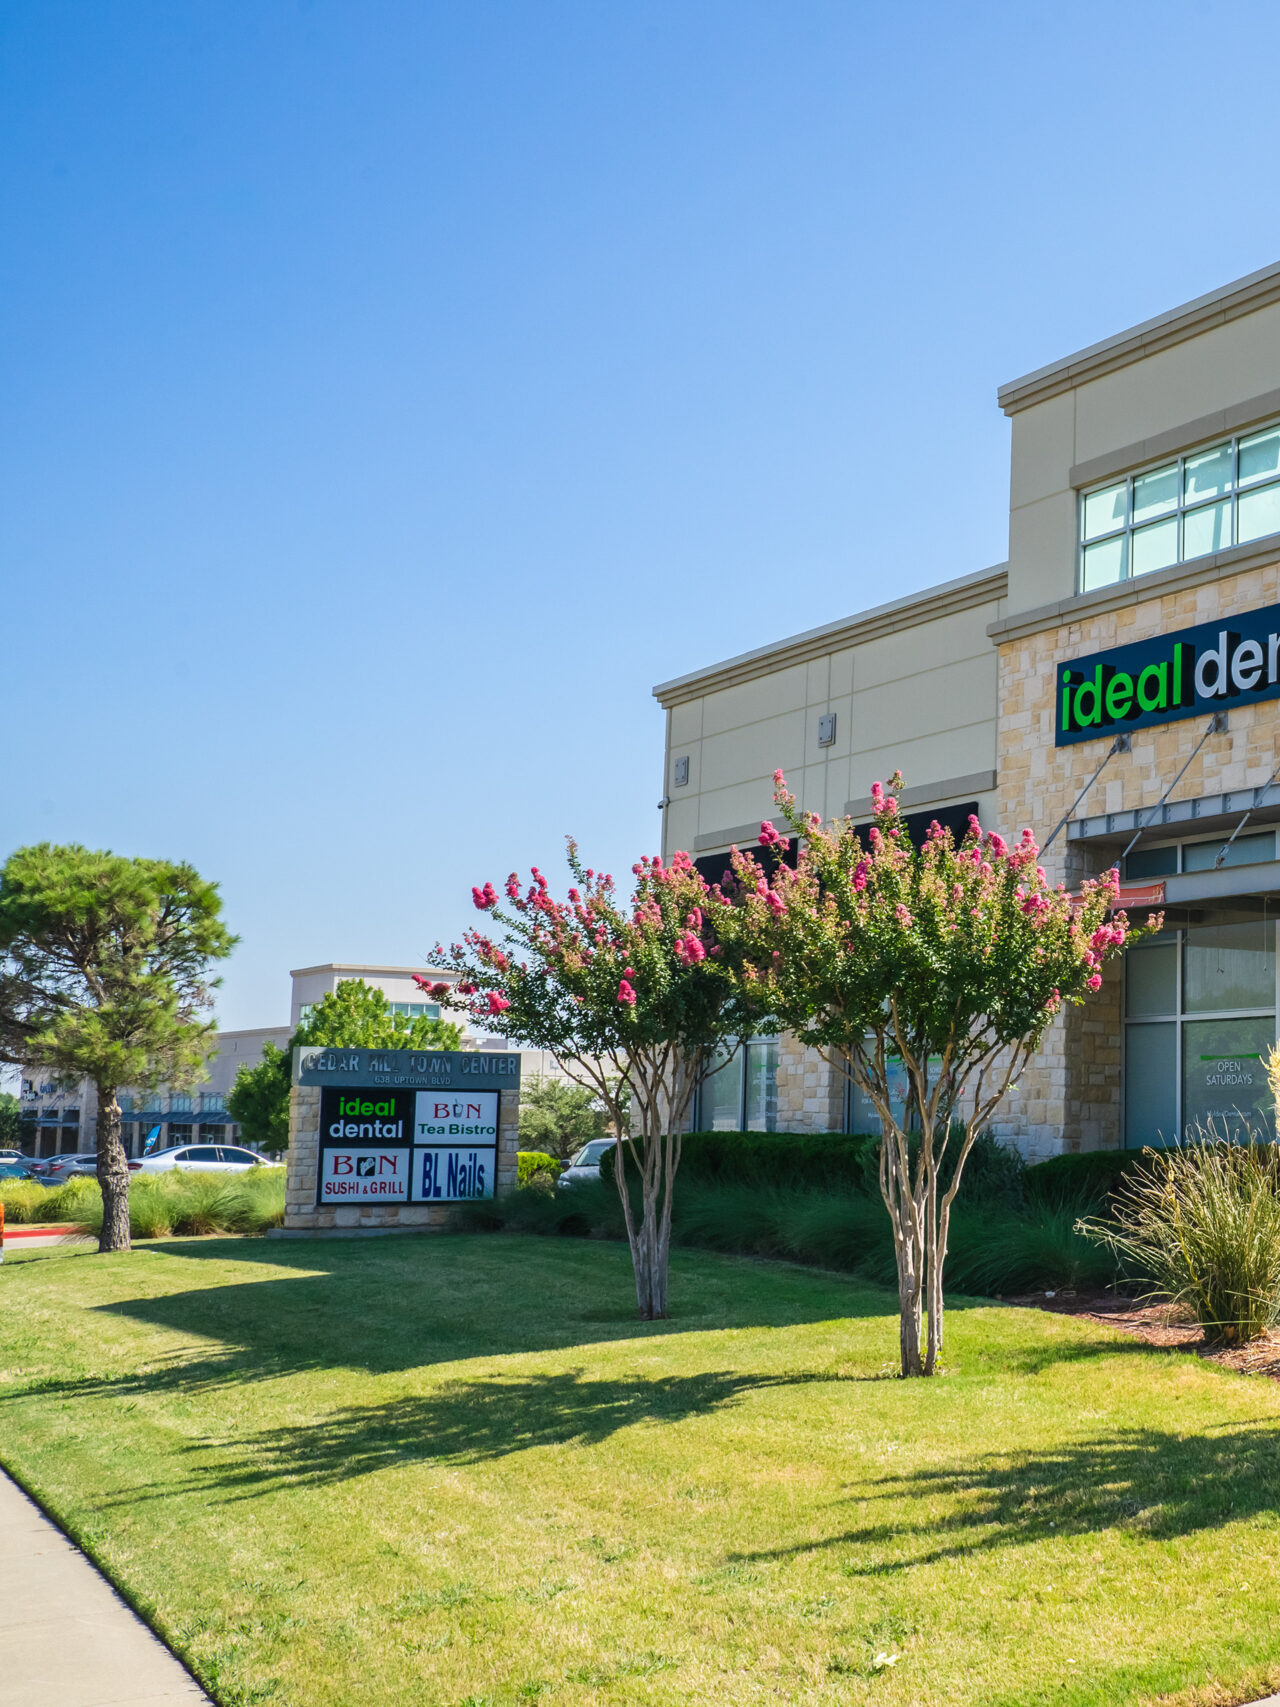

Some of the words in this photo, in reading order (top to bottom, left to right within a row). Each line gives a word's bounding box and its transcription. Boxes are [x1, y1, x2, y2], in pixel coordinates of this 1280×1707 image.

[1062, 642, 1183, 731] ideal
[304, 1052, 360, 1072] CEDAR
[409, 1055, 452, 1073] TOWN
[462, 1056, 517, 1075] CENTER
[1217, 1061, 1240, 1073] OPEN
[374, 1075, 390, 1084] 638
[394, 1076, 428, 1085] UPTOWN
[431, 1076, 451, 1085] BLVD
[1206, 1074, 1252, 1085] SATURDAYS
[339, 1097, 396, 1117] ideal
[329, 1119, 404, 1138] dental
[418, 1123, 445, 1135] Tea
[448, 1123, 496, 1135] Bistro
[421, 1152, 442, 1198] BL
[446, 1152, 485, 1198] Nails
[325, 1181, 359, 1195] SUSHI
[362, 1185, 369, 1195] &
[370, 1181, 404, 1194] GRILL
